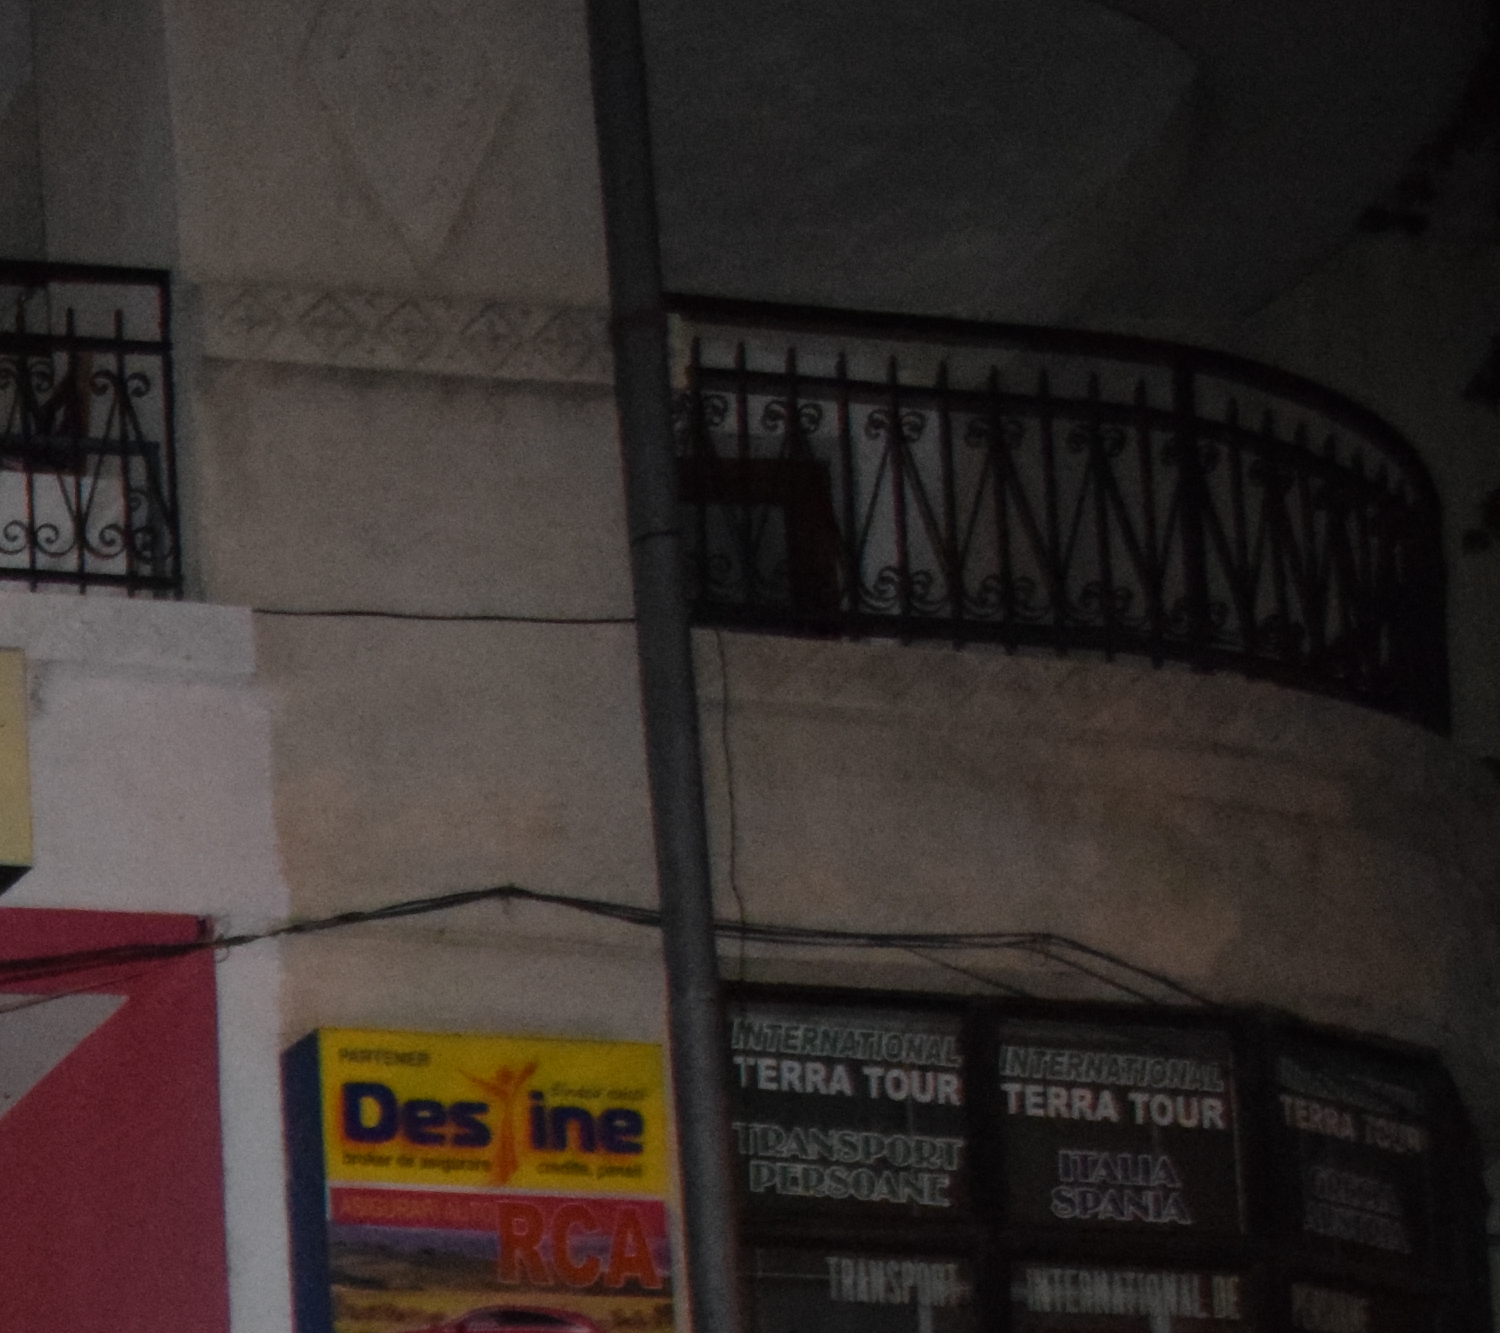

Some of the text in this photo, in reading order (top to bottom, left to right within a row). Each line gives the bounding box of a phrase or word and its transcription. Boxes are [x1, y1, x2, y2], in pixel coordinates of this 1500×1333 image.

[732, 1019, 963, 1066] INTERNATIONAL
[734, 1054, 962, 1107] TERRA TOUR
[999, 1045, 1225, 1092] INTERNATIONAL
[1000, 1083, 1226, 1130] TERRA TOUR
[732, 1121, 964, 1171] TRANSPORT
[1057, 1148, 1182, 1189] ITALIA
[749, 1160, 952, 1207] PERSOANE
[1050, 1186, 1193, 1225] SPANIA
[499, 1201, 664, 1290] RCA
